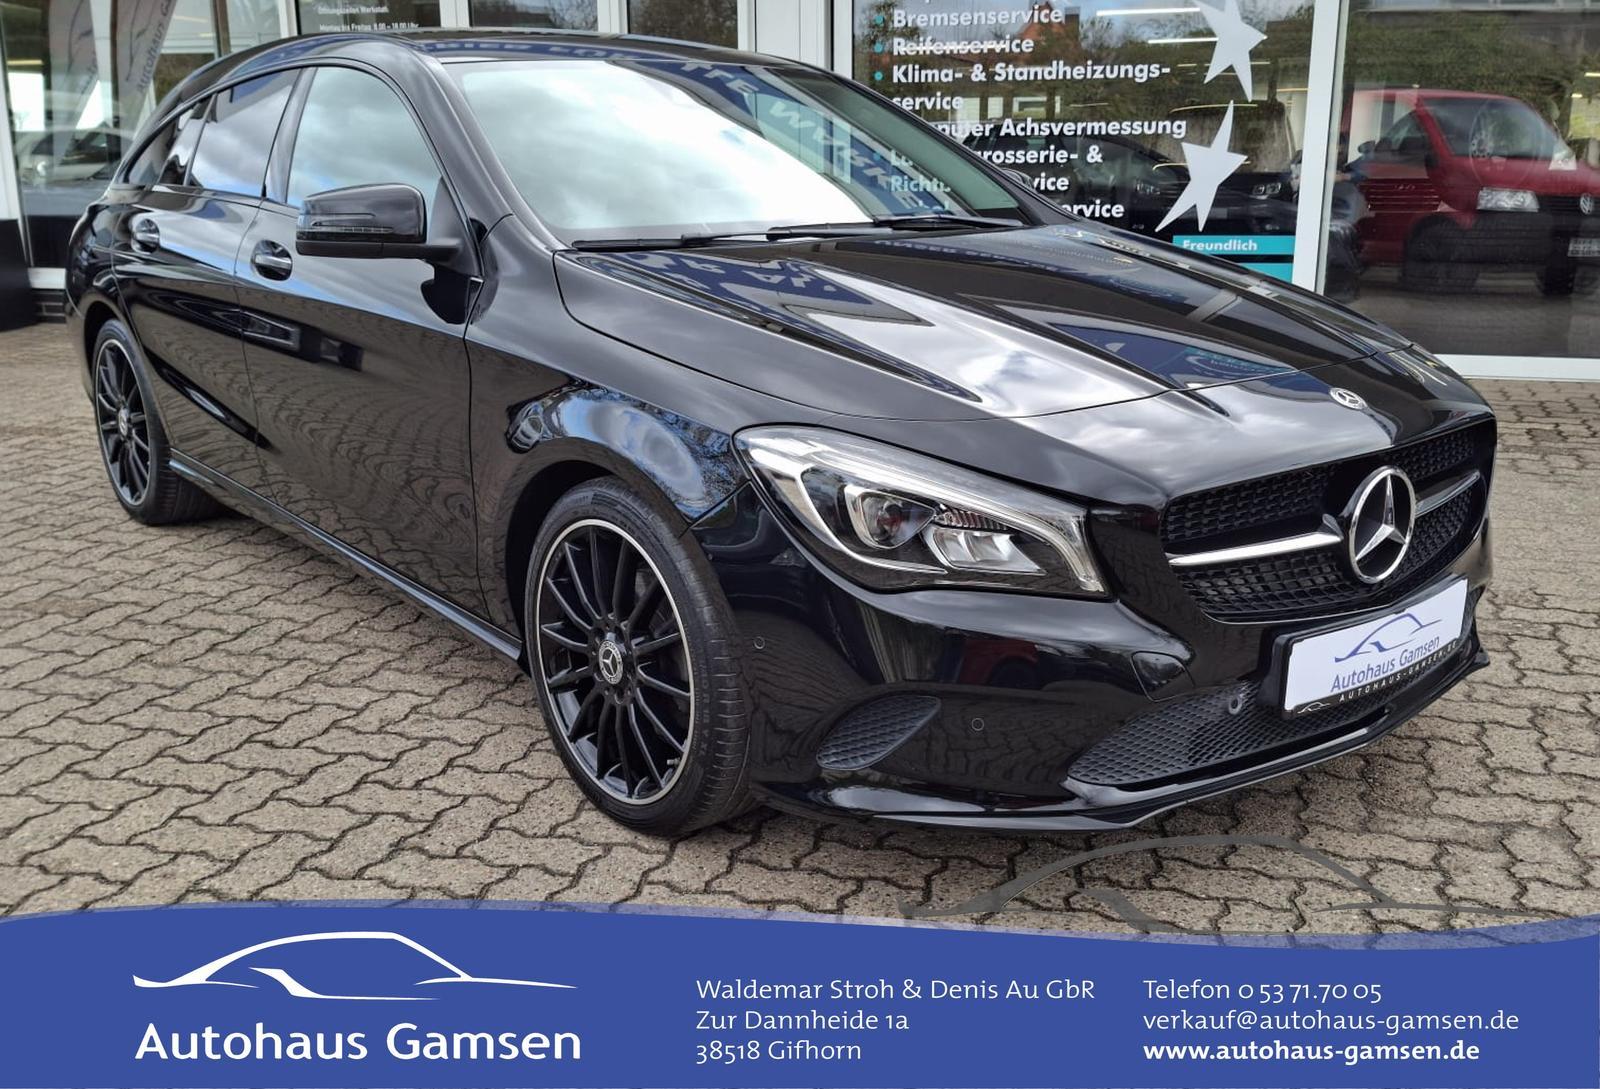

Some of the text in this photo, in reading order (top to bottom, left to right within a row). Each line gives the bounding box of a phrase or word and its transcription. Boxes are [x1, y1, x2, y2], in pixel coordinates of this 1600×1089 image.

[892, 5, 1063, 28] Bremsenservice
[892, 34, 1034, 56] Reifenservice
[892, 60, 1170, 83] Klima- & Standheizungs-
[1000, 117, 1187, 139] Achsvermessung
[977, 144, 1103, 164] rosserie- &
[1183, 239, 1258, 251] Freundlich
[1330, 636, 1440, 693] Autohaus Gamsen
